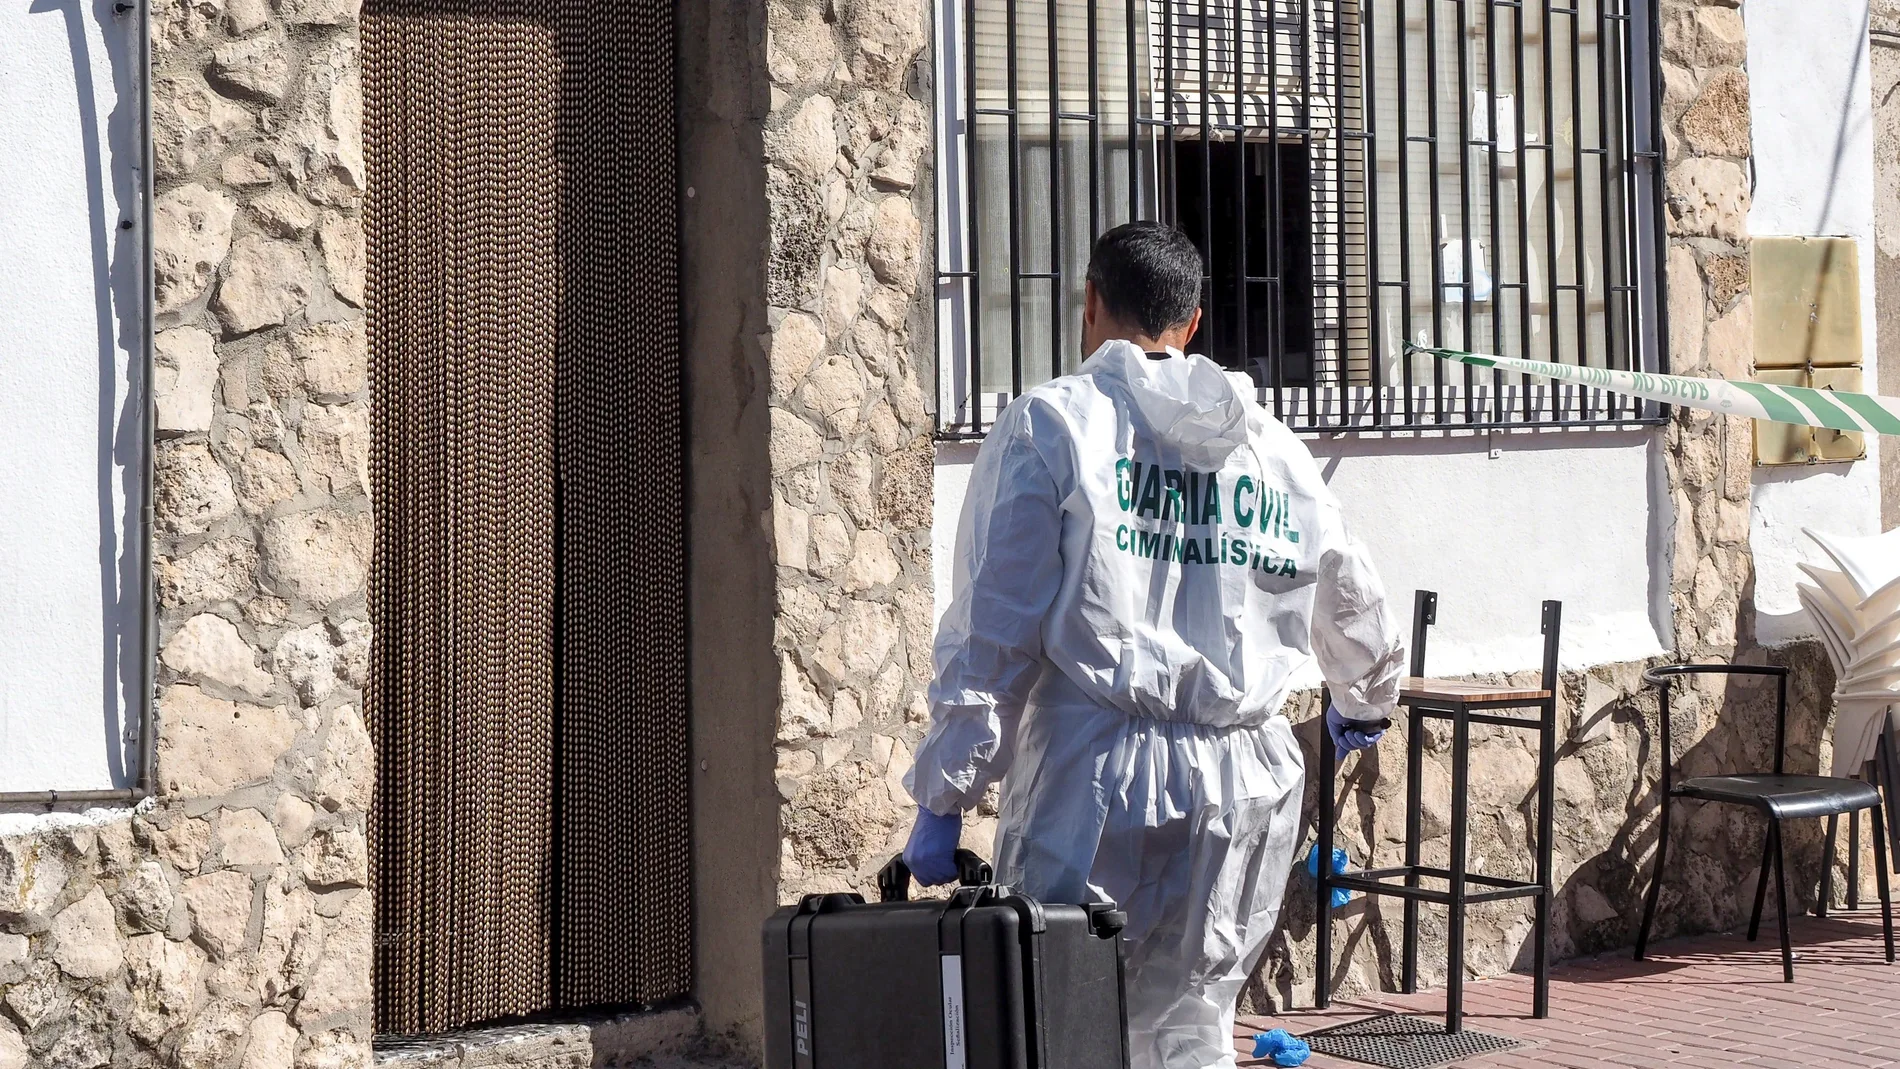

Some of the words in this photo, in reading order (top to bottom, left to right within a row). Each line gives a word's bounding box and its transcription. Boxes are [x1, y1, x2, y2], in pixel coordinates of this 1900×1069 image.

[1115, 457, 1222, 525] GARIA
[1234, 475, 1299, 543] CVIL
[796, 1000, 808, 1055] PELI
